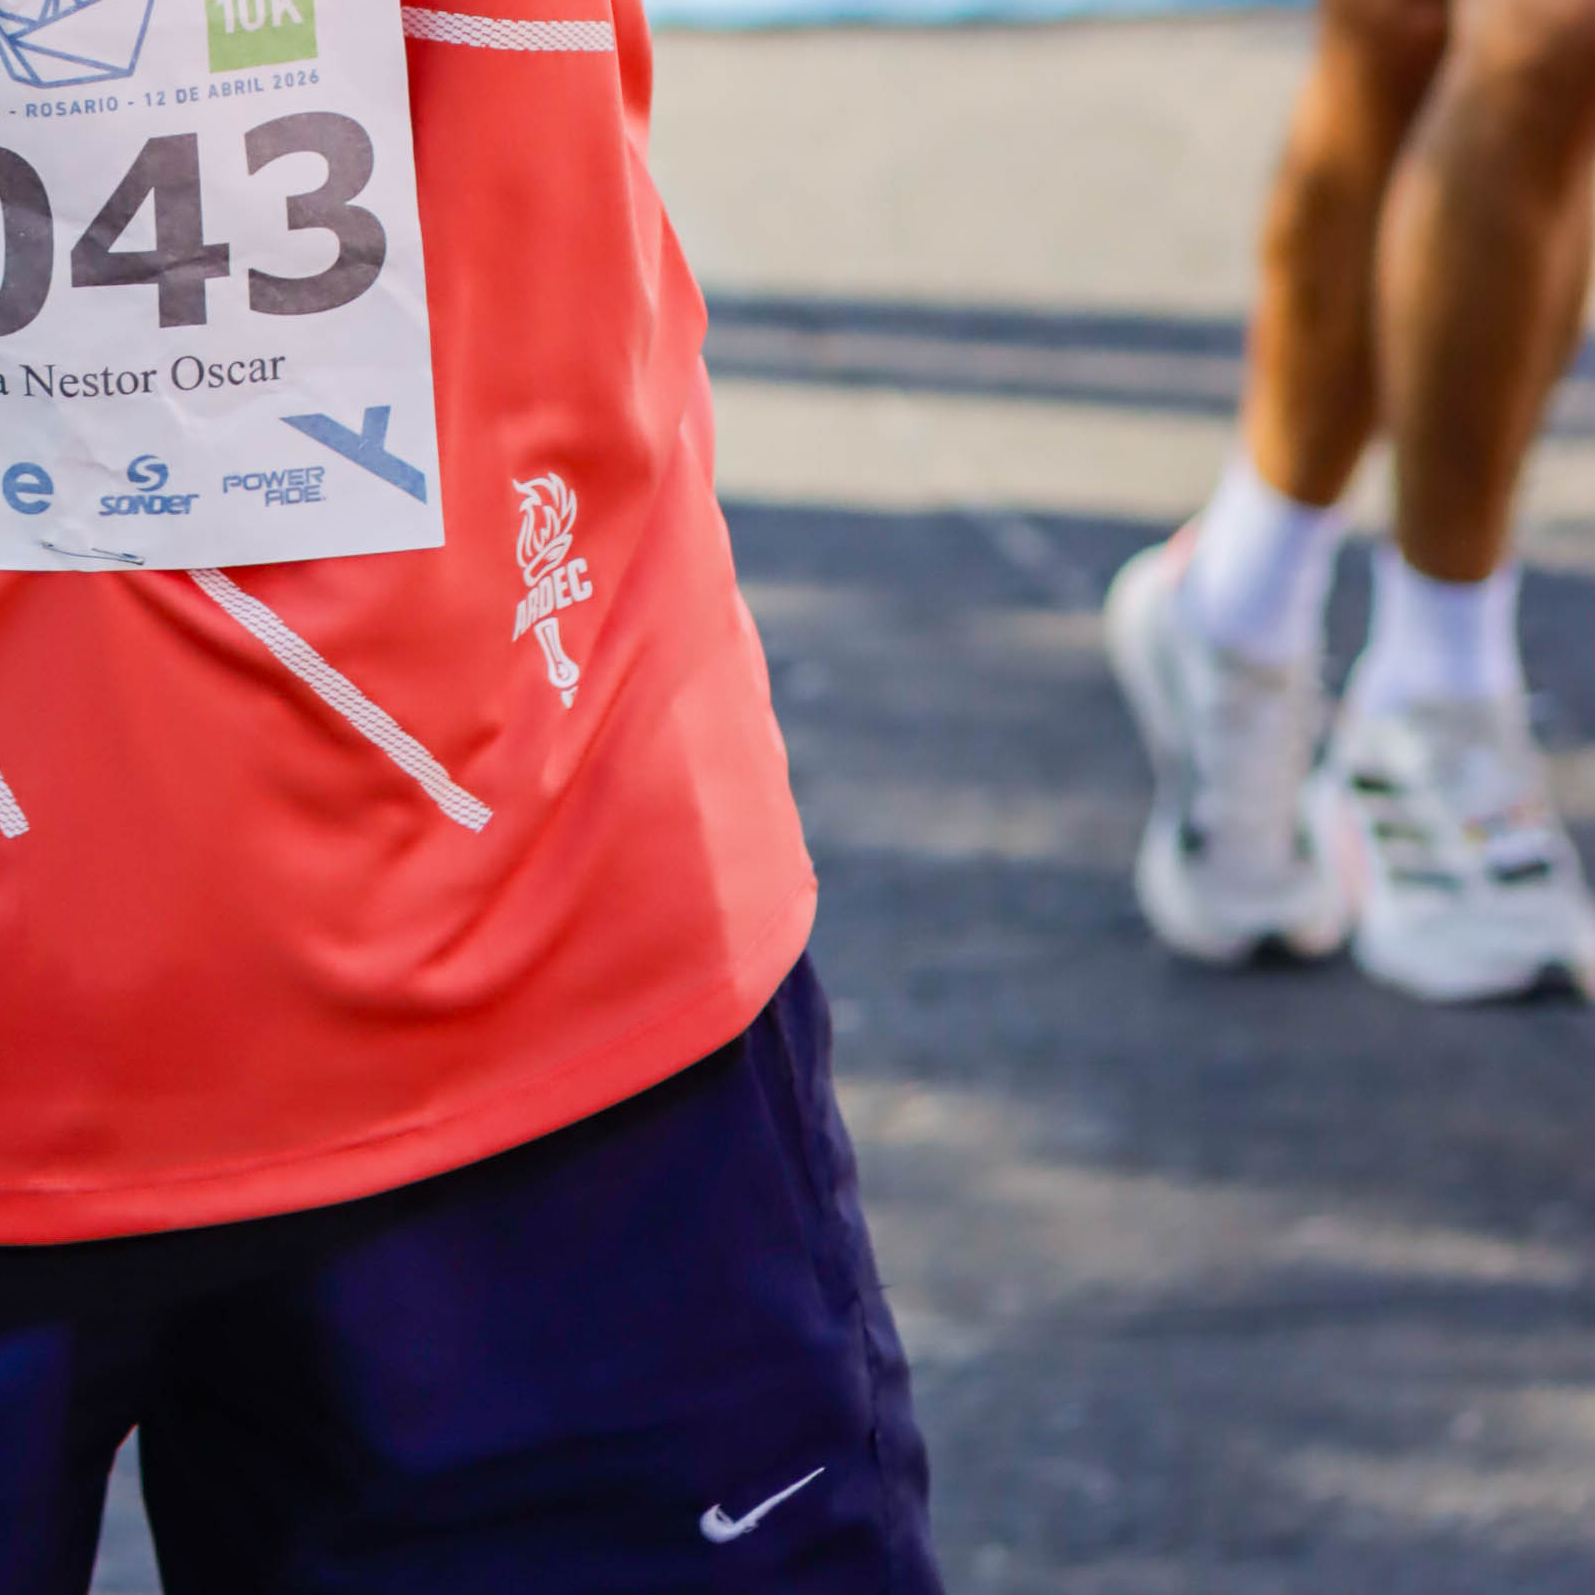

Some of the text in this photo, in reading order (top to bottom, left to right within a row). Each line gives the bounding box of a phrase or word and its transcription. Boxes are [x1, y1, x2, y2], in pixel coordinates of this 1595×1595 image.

[25, 96, 119, 118] ROSARIO
[145, 92, 167, 107] 12
[175, 86, 199, 105] DE
[208, 75, 264, 100] ABRIL
[273, 68, 320, 90] 2026
[17, 363, 158, 399] Nestor
[170, 354, 286, 391] Oscar
[222, 465, 325, 494] POWER
